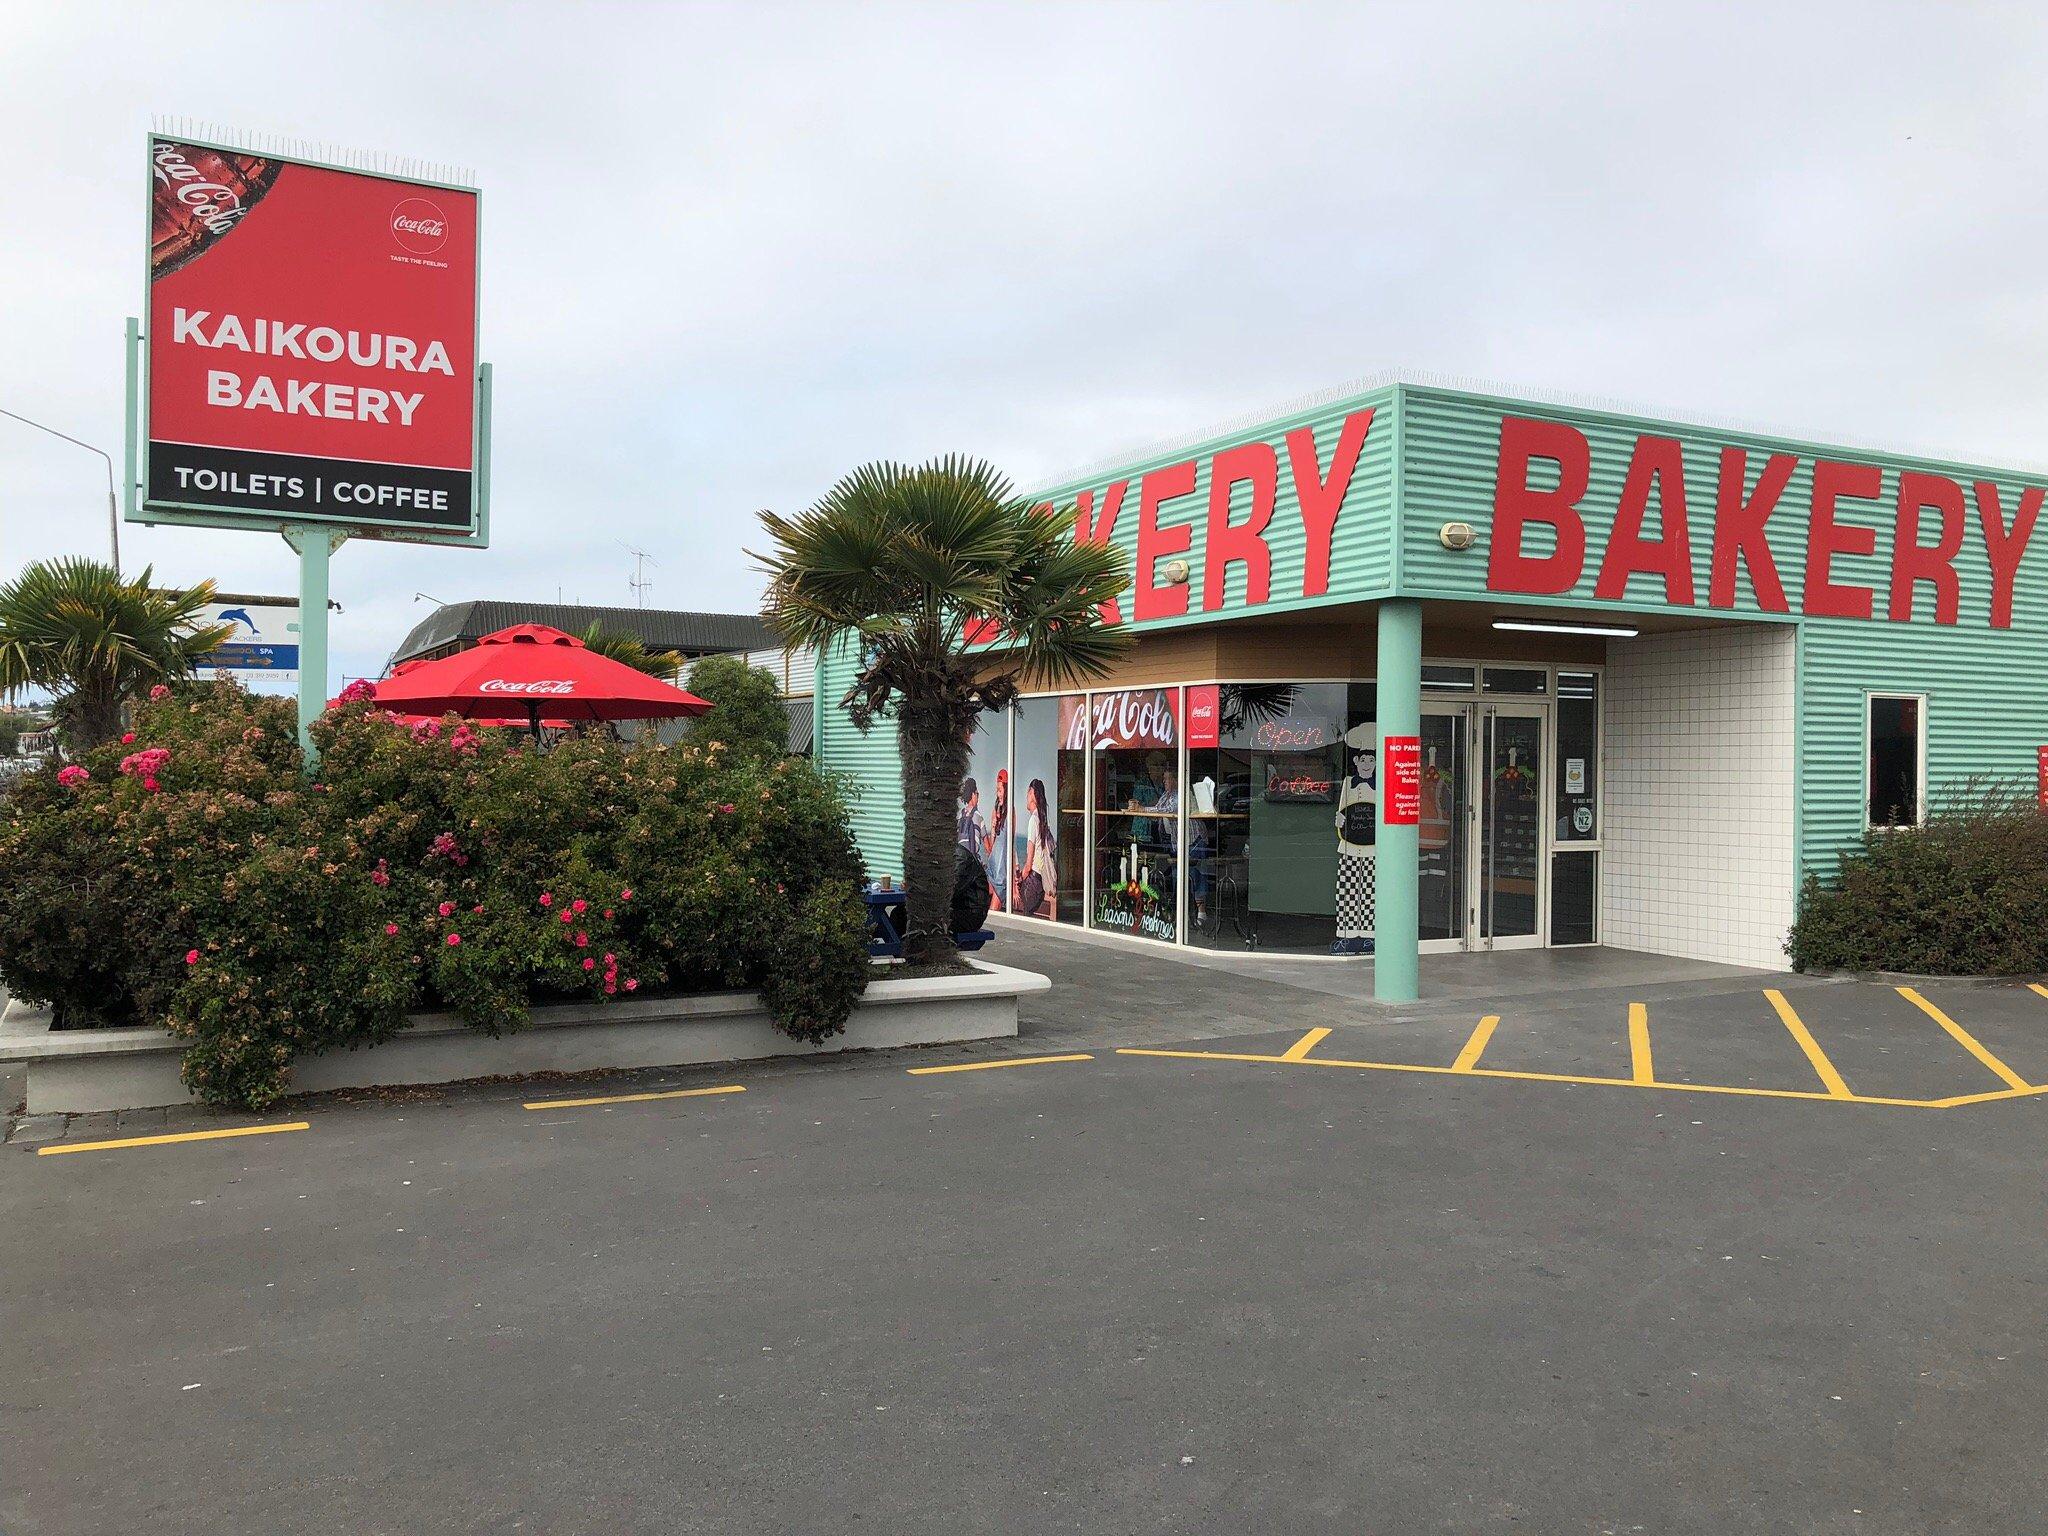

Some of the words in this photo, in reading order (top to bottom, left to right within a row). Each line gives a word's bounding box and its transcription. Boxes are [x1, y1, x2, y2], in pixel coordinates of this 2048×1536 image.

[154, 143, 247, 235] oca-Cola
[393, 214, 446, 237] Coca-Cola
[390, 254, 410, 263] TASTE
[410, 257, 422, 265] THE
[423, 259, 449, 269] FEELING
[173, 307, 455, 376] KAIKOURA
[207, 369, 425, 426] BAKERY
[174, 466, 304, 498] TOILETS
[333, 482, 449, 511] COFFEE
[963, 407, 1376, 645] KERY
[1486, 416, 2048, 629] BAKERY
[259, 647, 274, 655] SPA
[480, 679, 579, 694] Coca-Cola
[1257, 721, 1323, 753] Open
[1389, 744, 1402, 752] NO
[1394, 761, 1416, 769] Against
[1394, 792, 1414, 800] Please
[1395, 801, 1416, 809] against
[1578, 816, 1589, 825] NZ
[1096, 894, 1134, 927] Seasons
